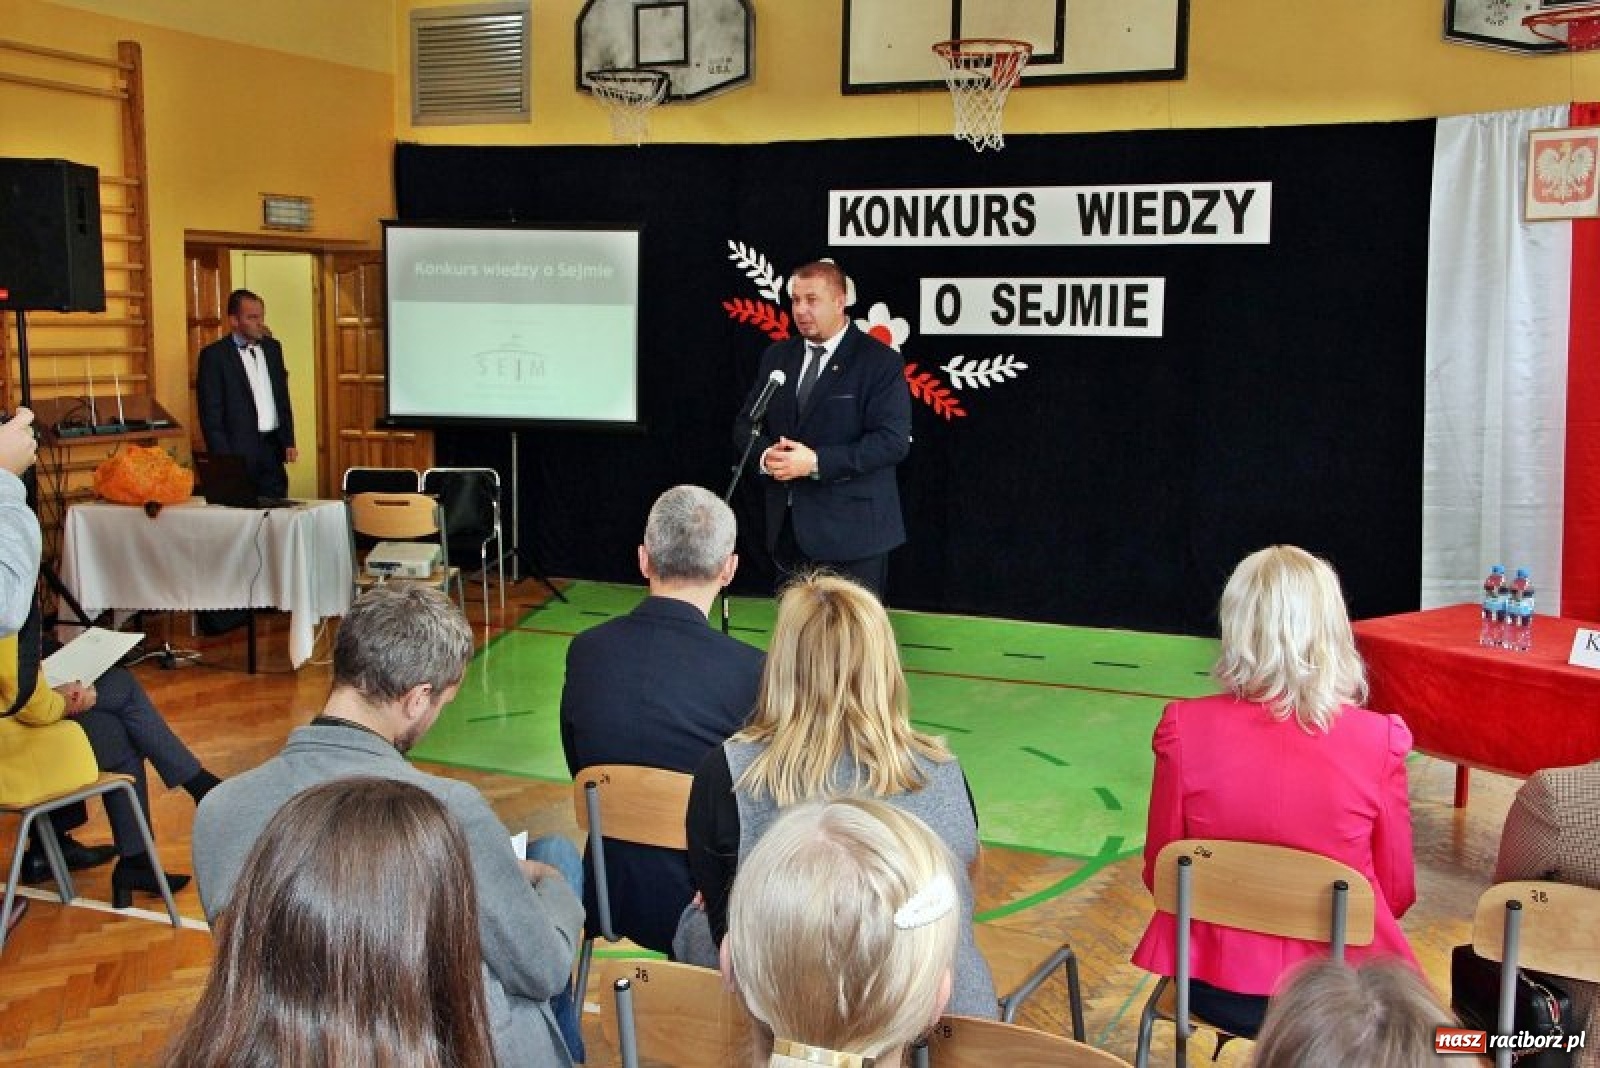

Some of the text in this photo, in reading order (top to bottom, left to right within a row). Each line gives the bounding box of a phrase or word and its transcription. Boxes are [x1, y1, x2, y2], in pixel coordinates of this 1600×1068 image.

[839, 189, 1256, 237] KONKURS WIEDZY
[414, 260, 614, 281] Konkurs wiedzy o Sejmie
[934, 282, 1149, 327] O SEJMIE
